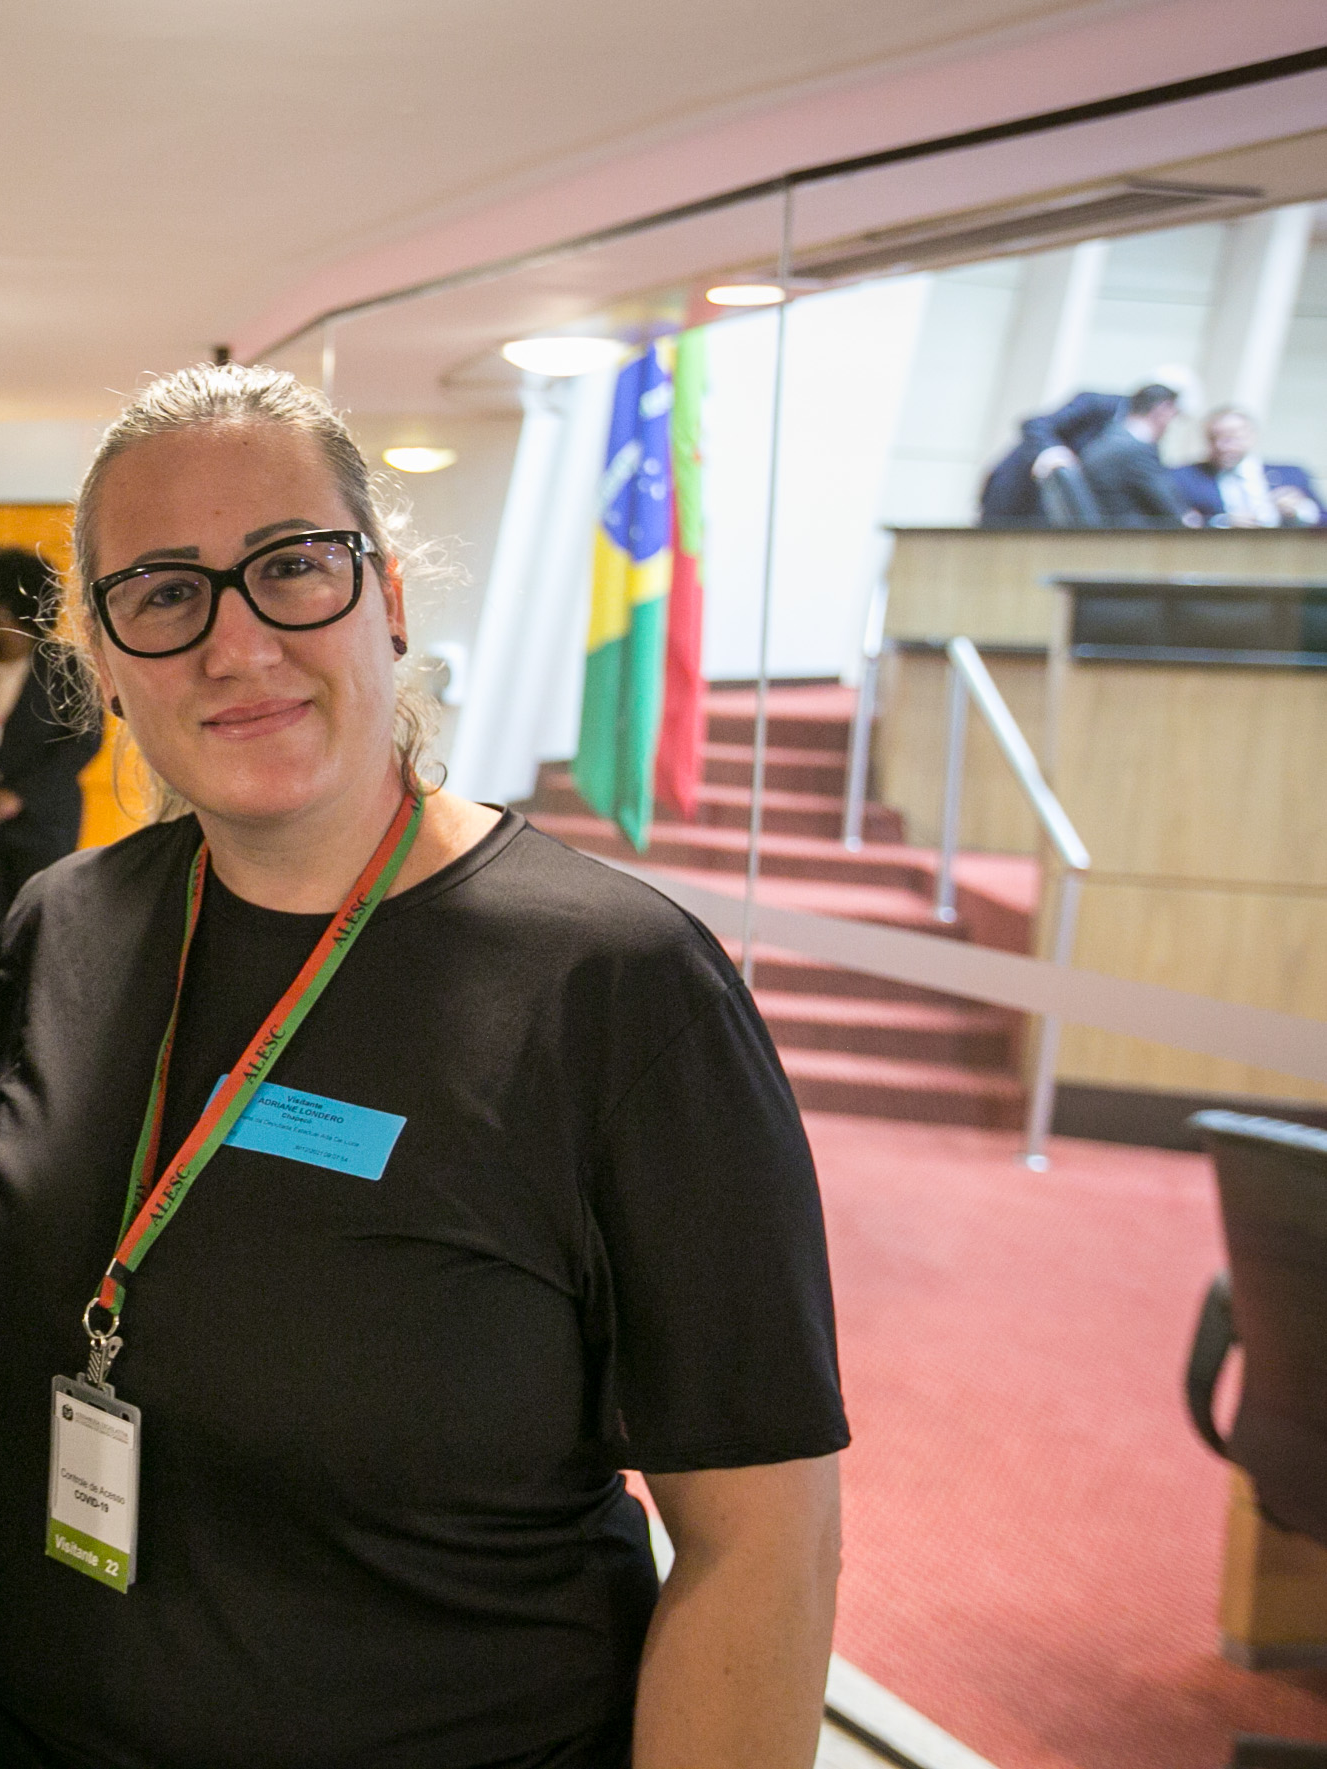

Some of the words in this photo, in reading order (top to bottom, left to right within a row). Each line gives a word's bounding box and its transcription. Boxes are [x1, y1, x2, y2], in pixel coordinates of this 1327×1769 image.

[332, 892, 373, 949] ALESC
[243, 1024, 286, 1085] ALESC
[258, 1097, 298, 1114] ADRIANE
[299, 1107, 345, 1124] LONDERO
[287, 1095, 323, 1109] Visitante
[149, 1163, 190, 1227] ALESC
[61, 1467, 89, 1488] Controle
[89, 1481, 98, 1493] de
[99, 1486, 125, 1505] Acesso
[74, 1490, 109, 1513] COVID-19
[55, 1534, 99, 1567] Visitante
[105, 1559, 120, 1577] 22
